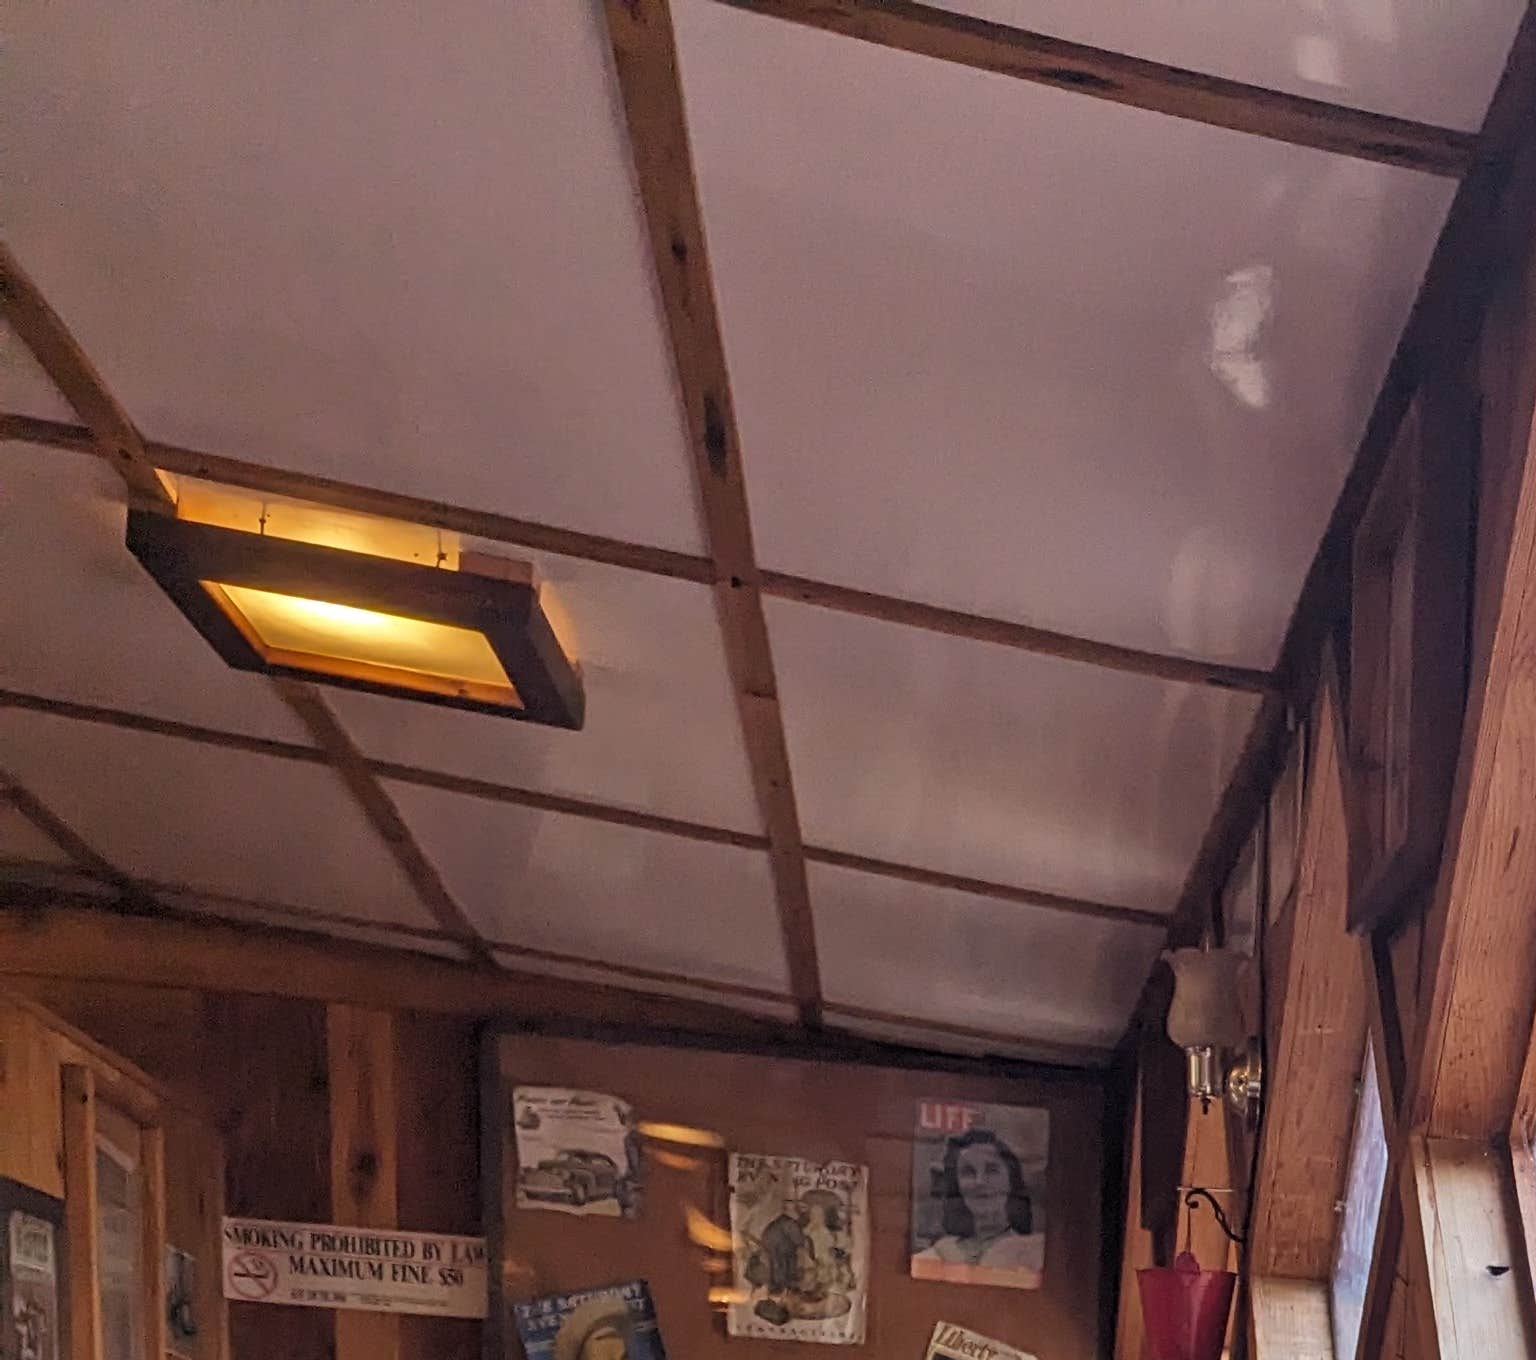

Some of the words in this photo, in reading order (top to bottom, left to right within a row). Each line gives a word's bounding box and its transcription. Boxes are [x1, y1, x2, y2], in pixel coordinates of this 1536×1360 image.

[920, 1102, 983, 1129] LIFE
[224, 1226, 304, 1250] SMOKING
[310, 1231, 416, 1259] PROHIBITED
[422, 1241, 445, 1261] BY
[288, 1255, 384, 1282] MAXIMUM
[391, 1262, 430, 1285] FINE
